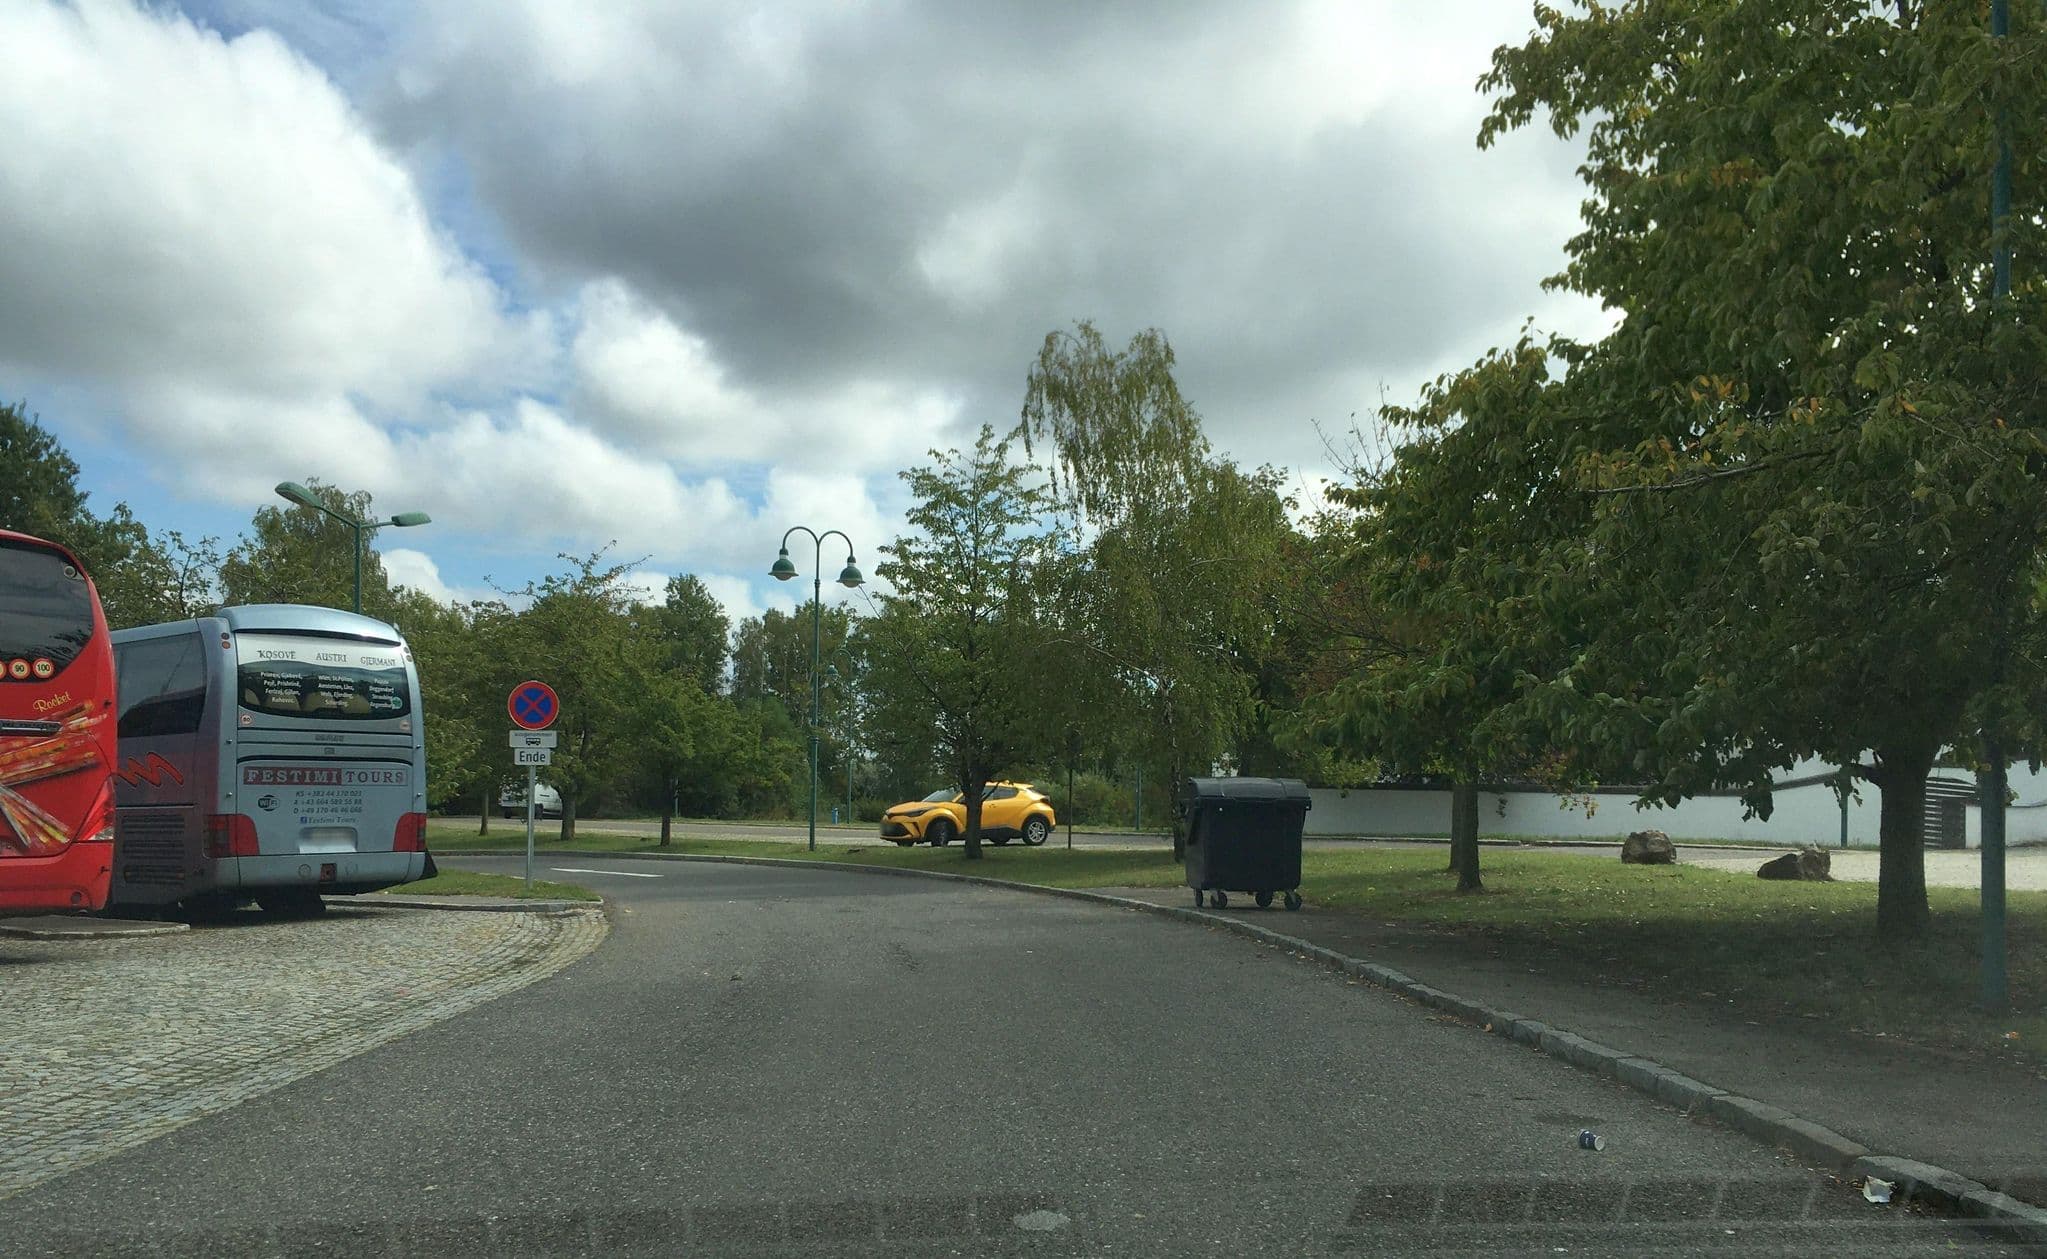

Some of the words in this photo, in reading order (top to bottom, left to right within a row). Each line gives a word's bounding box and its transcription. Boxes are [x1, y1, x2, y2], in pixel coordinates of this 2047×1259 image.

[316, 652, 347, 662] AUSTRI
[15, 664, 25, 672] 90
[37, 664, 50, 672] 100
[33, 691, 71, 712] Rocket
[519, 750, 546, 762] Ende
[246, 769, 338, 783] FESTIMI
[345, 771, 404, 783] TOURS
